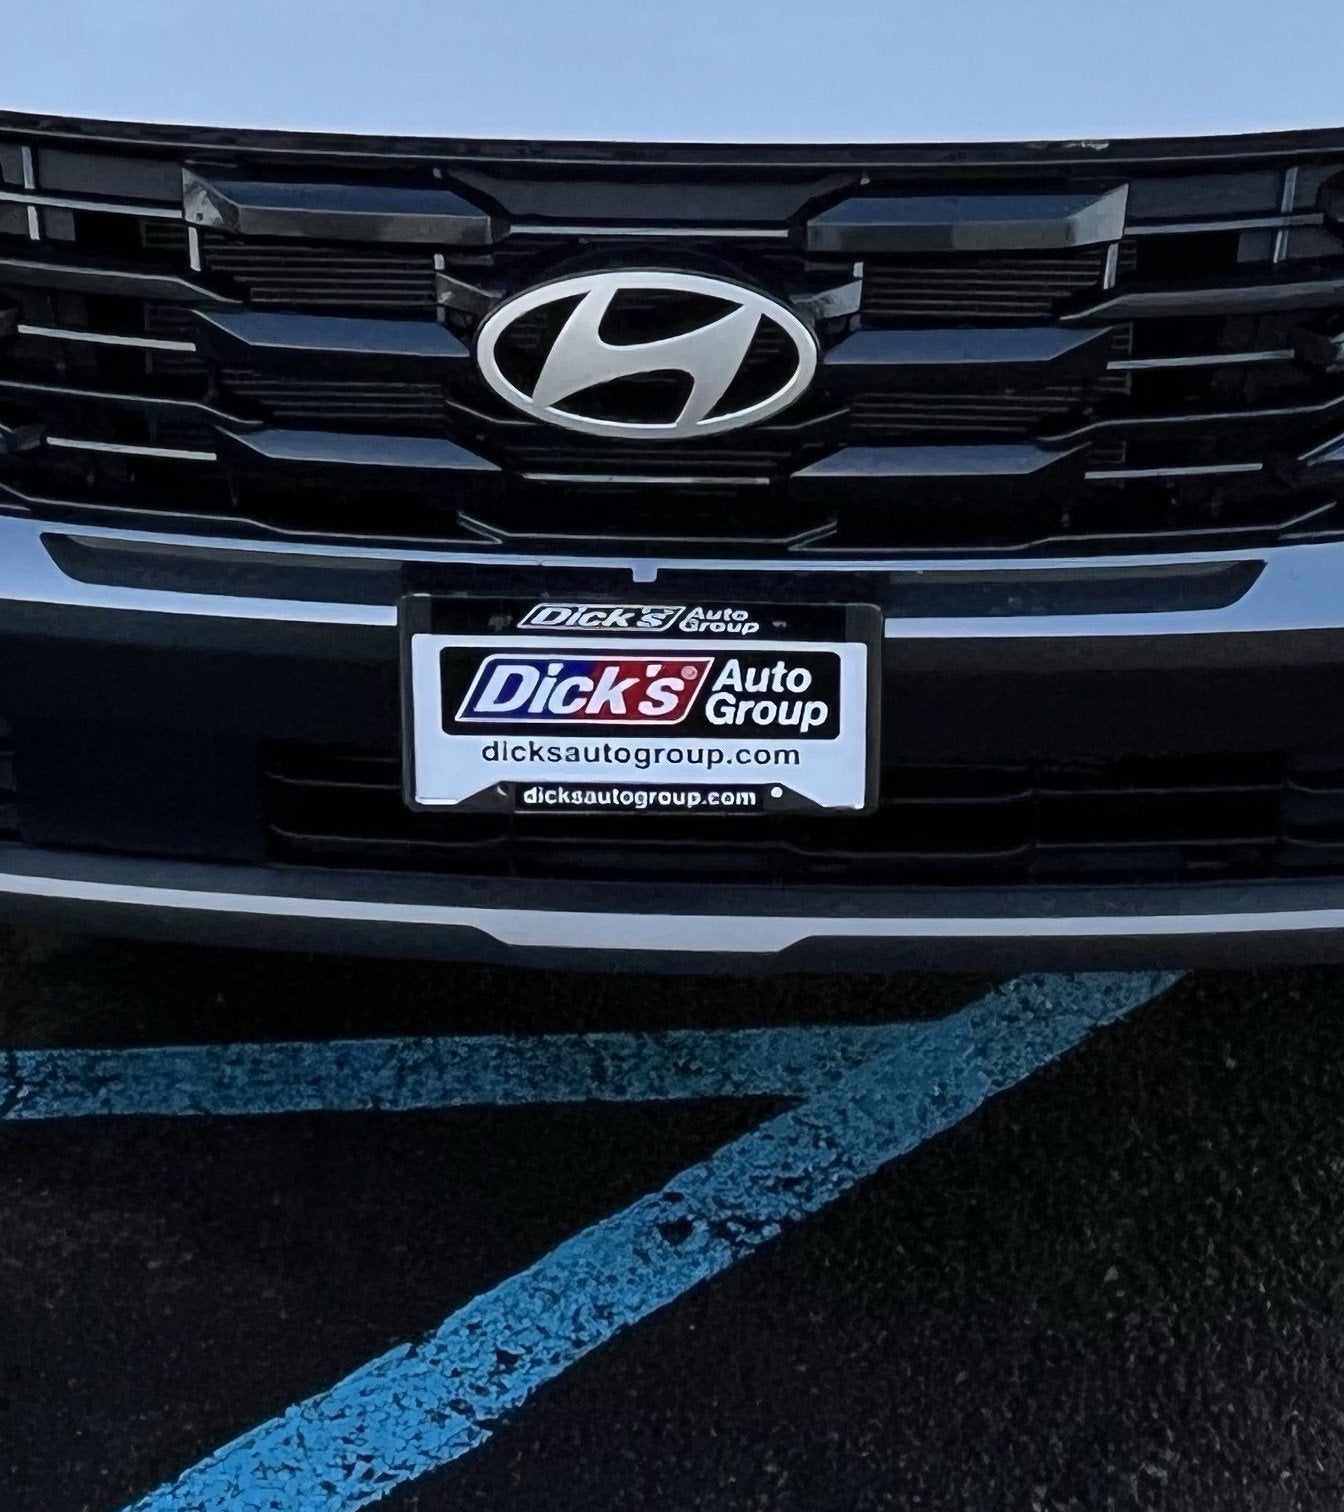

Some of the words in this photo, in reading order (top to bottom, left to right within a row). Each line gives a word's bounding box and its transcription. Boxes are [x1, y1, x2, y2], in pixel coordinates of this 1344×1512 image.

[530, 605, 668, 629] Dick's
[686, 605, 750, 622] Auto
[678, 619, 760, 635] Group
[472, 662, 685, 717] Dick's
[712, 659, 812, 694] Auto
[705, 693, 829, 733] Group
[481, 740, 801, 769] dicksautogroup.com
[523, 786, 757, 808] dicksautogroup.com
